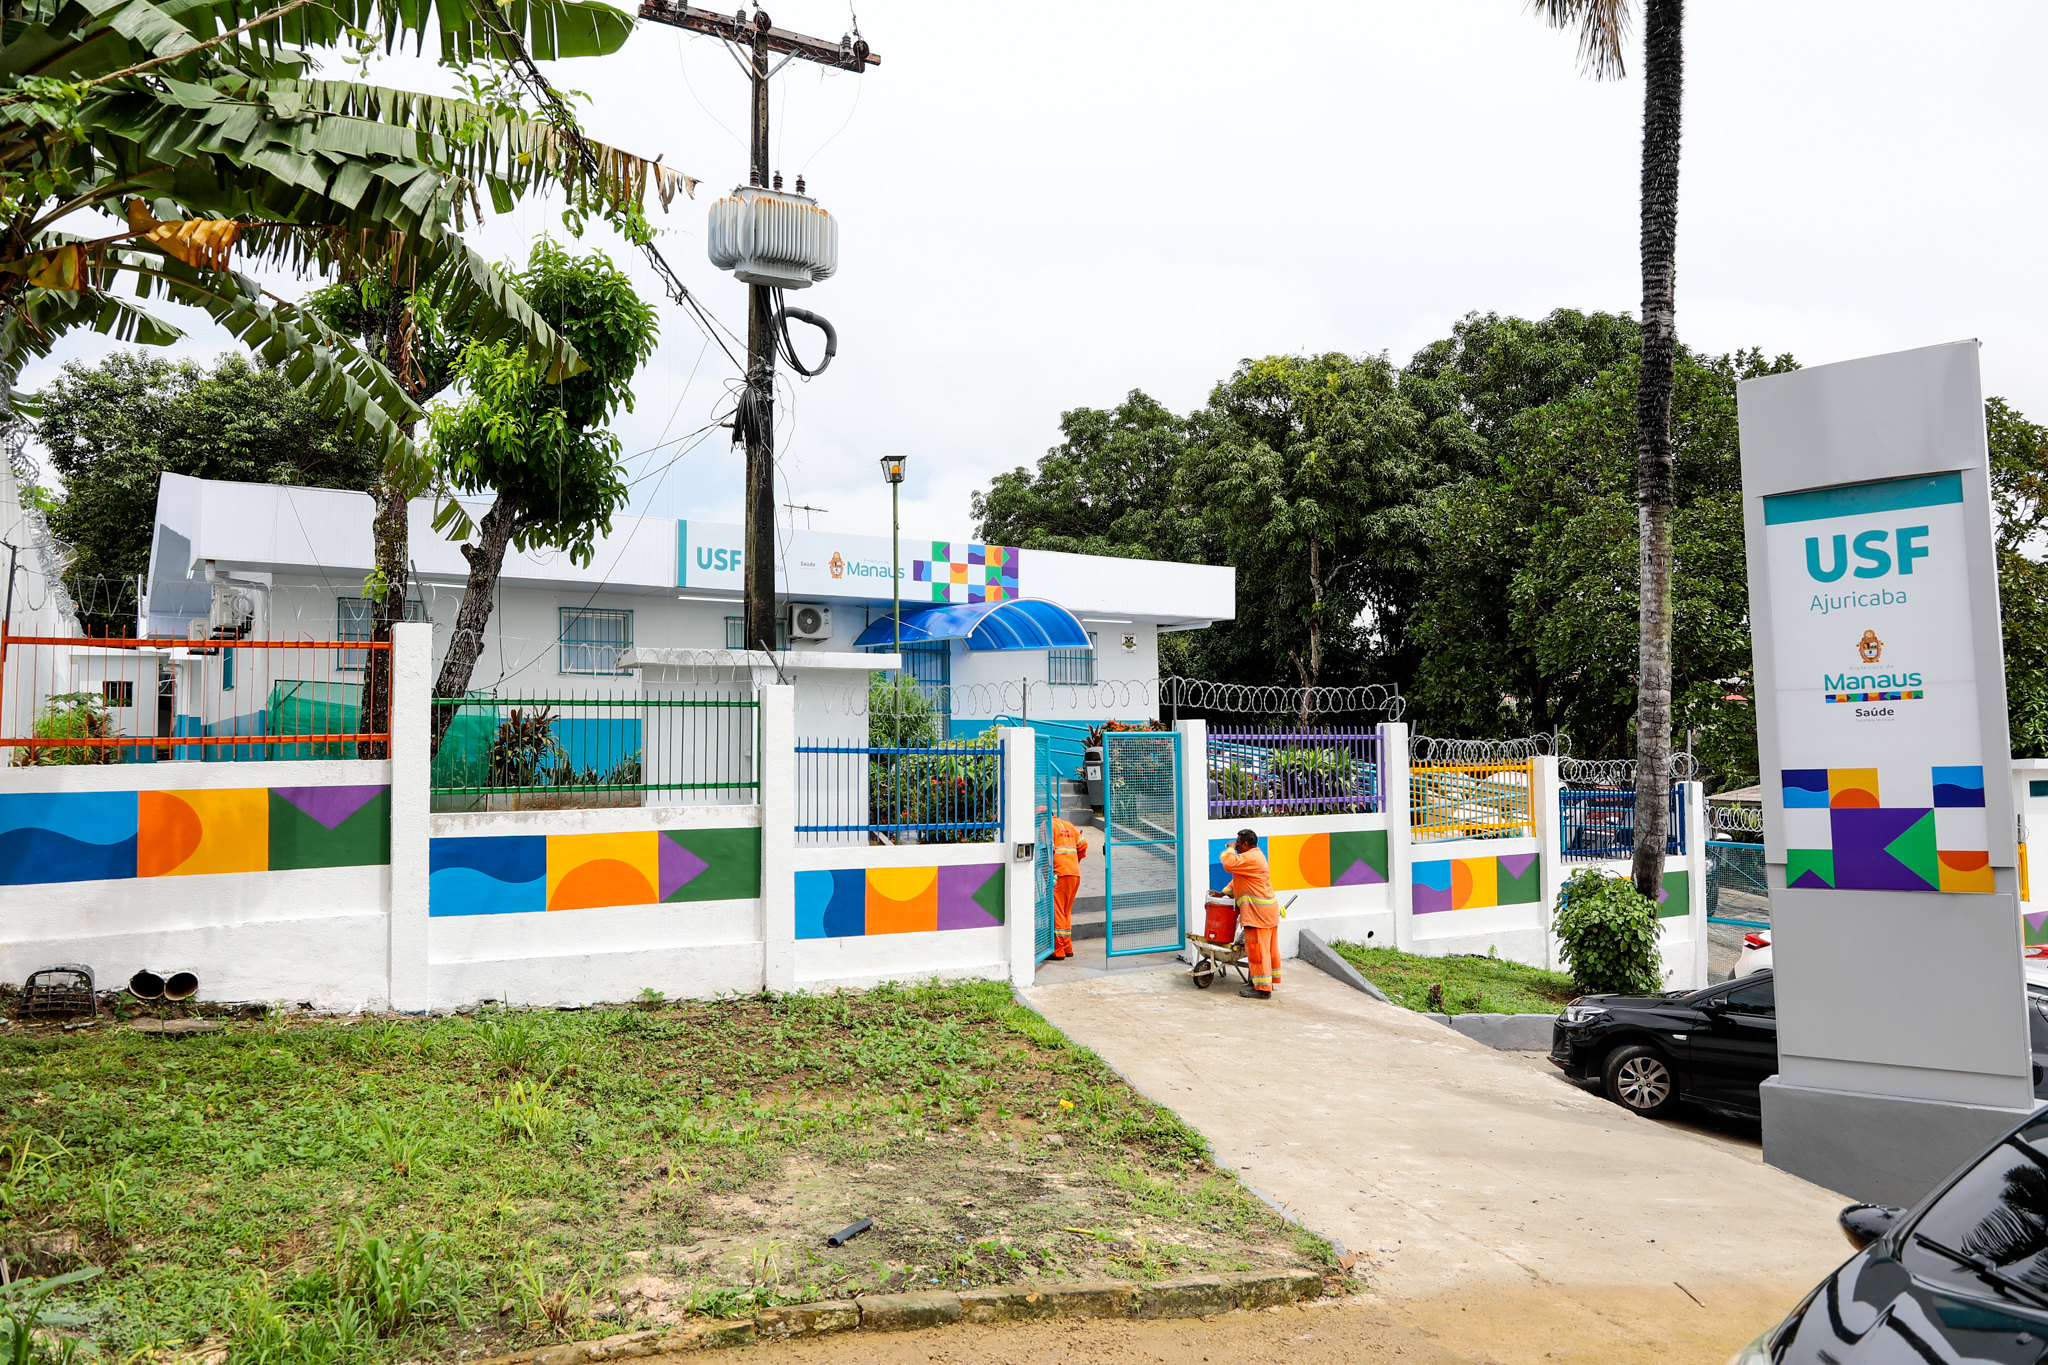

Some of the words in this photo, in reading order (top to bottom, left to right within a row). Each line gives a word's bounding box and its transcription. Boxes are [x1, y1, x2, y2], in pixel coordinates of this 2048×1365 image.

[696, 546, 742, 572] USF
[1805, 525, 1929, 583] USF
[847, 561, 905, 579] Manaus
[1809, 588, 1907, 615] Ajuricaba
[1824, 672, 1922, 692] Manaus
[1855, 707, 1895, 717] Saúde
